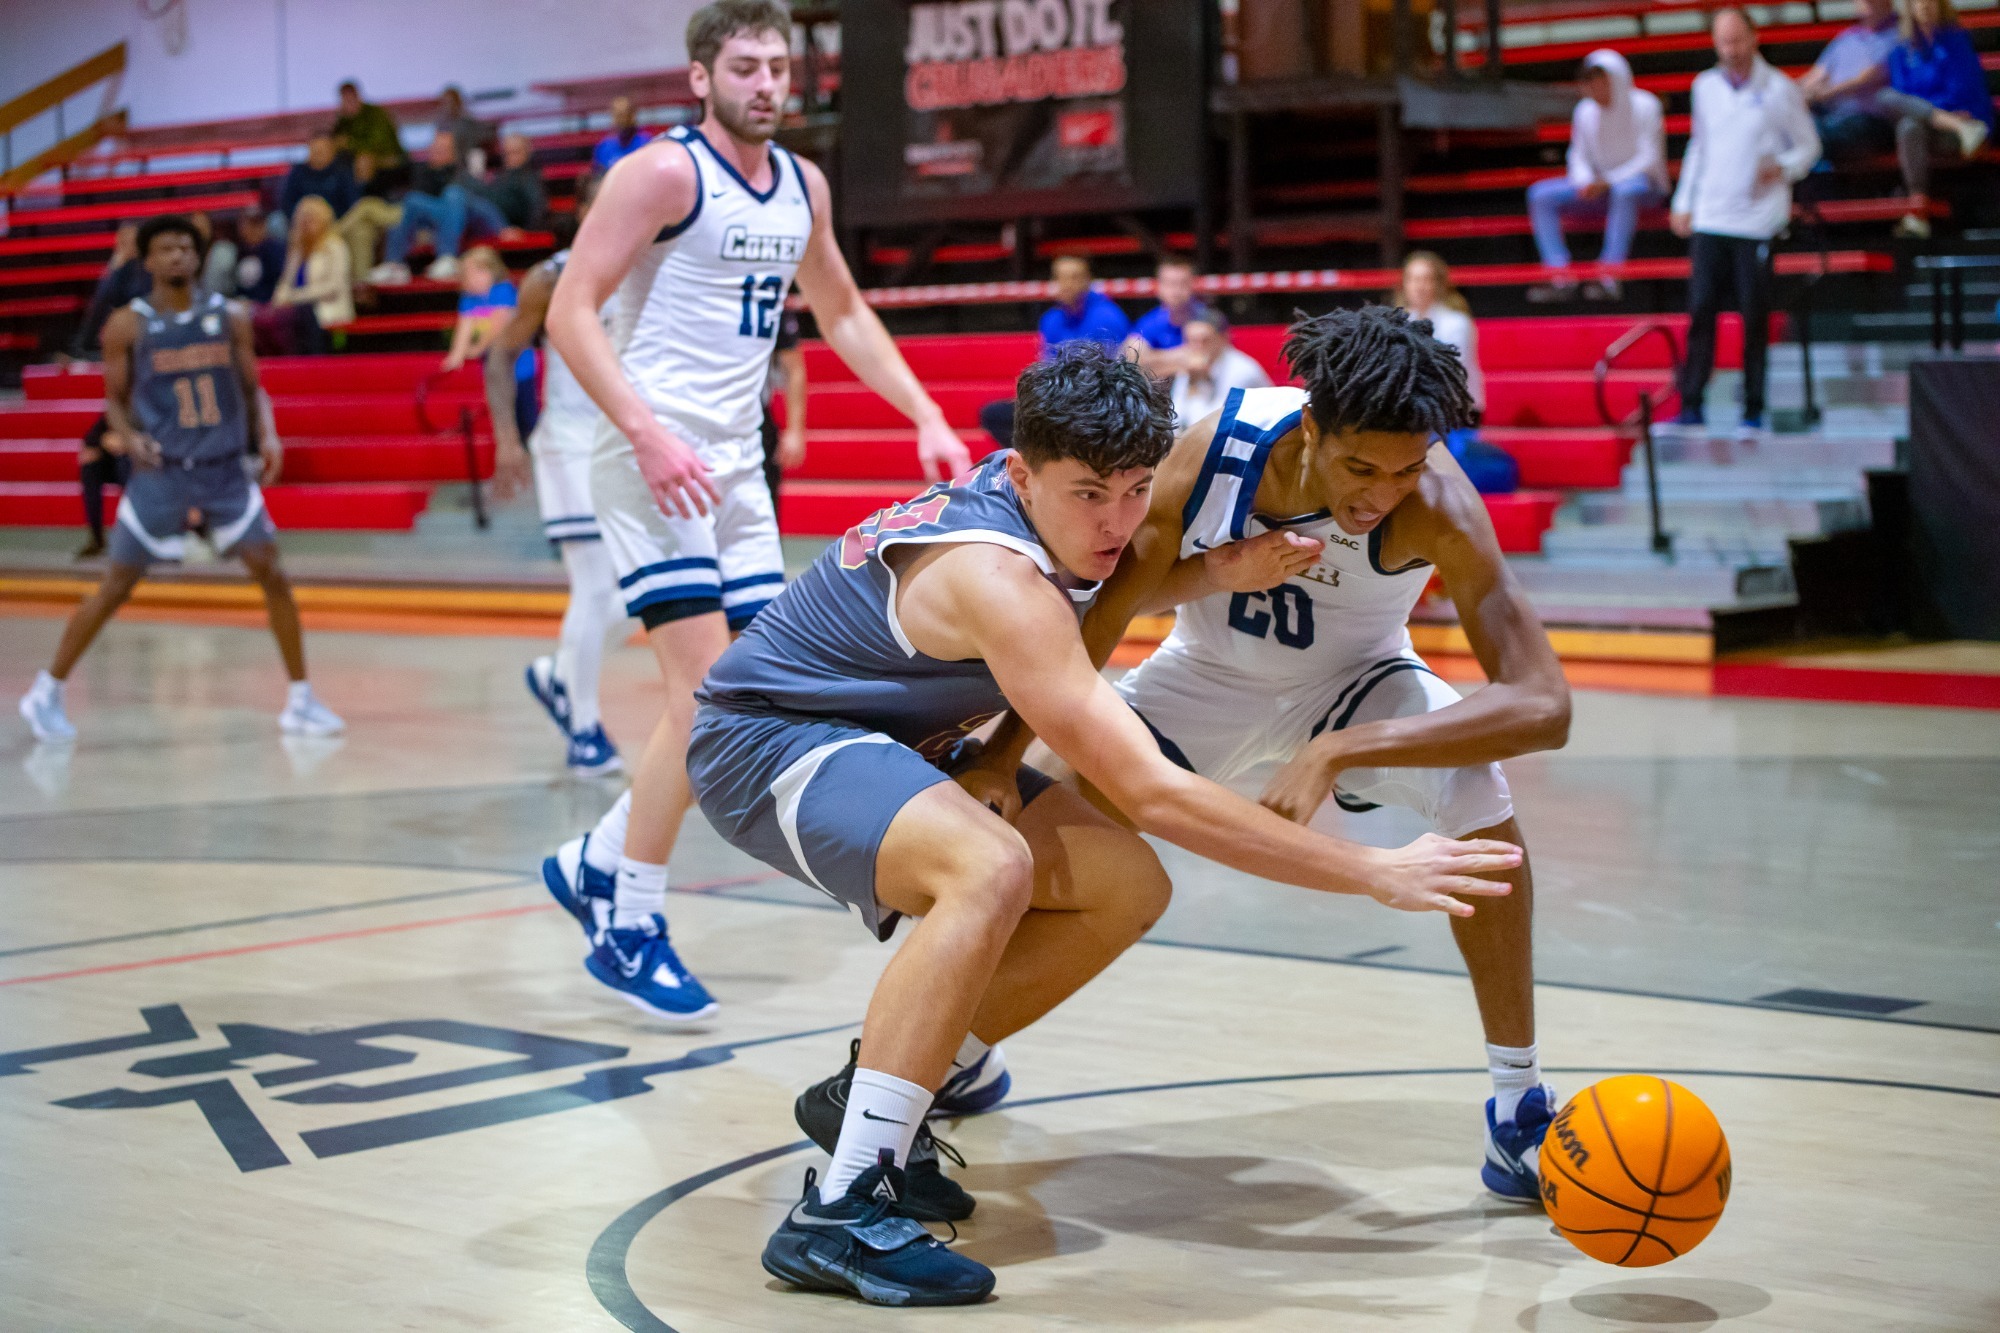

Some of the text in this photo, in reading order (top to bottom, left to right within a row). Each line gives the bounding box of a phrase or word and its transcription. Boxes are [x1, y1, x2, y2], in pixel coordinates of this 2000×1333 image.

[905, 3, 998, 62] JUST
[1003, 0, 1067, 53] DO
[739, 275, 782, 338] 12
[173, 373, 222, 428] 11
[1329, 533, 1360, 551] SAC
[1228, 582, 1314, 650] 20
